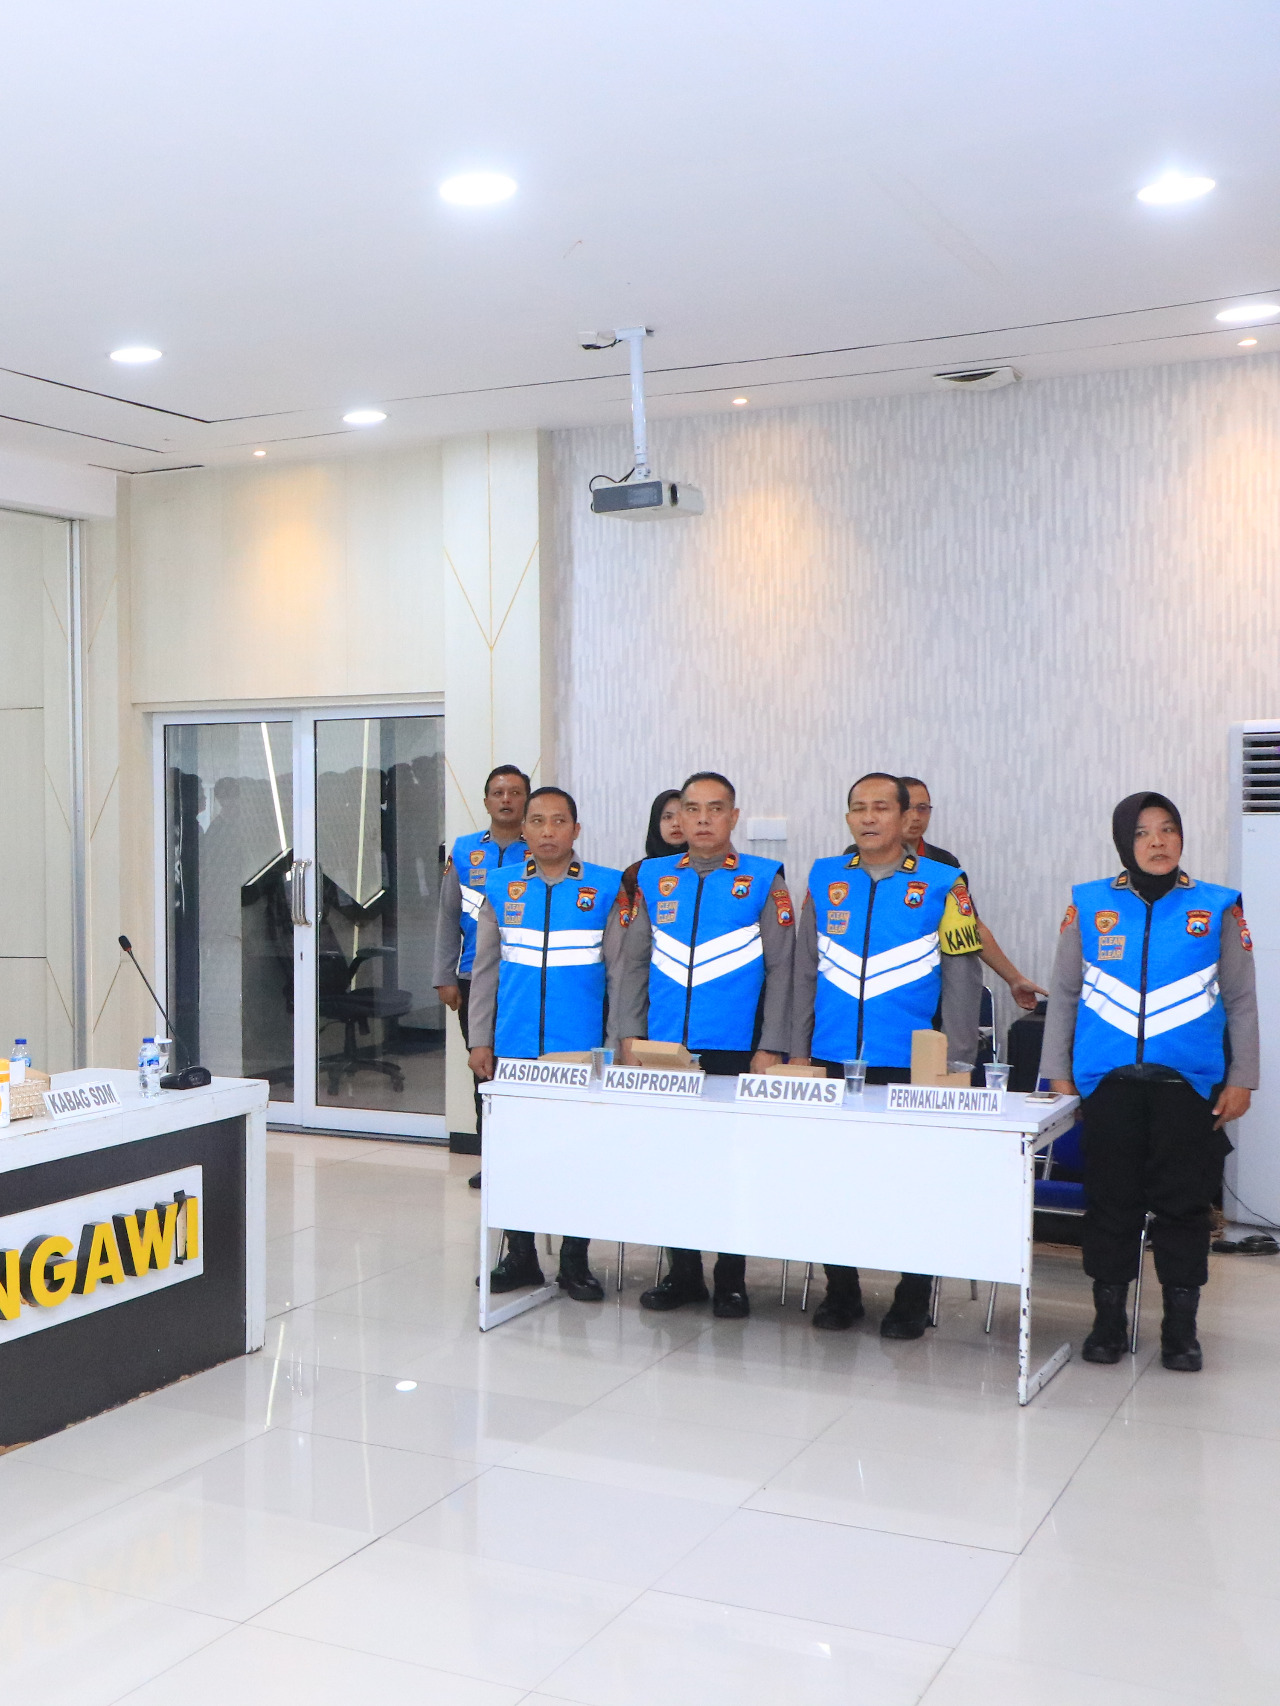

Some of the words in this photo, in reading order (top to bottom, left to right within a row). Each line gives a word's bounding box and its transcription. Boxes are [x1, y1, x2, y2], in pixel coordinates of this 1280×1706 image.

[498, 1062, 588, 1086] KASIDOKKES
[605, 1070, 700, 1094] KASIPROPAM
[47, 1089, 91, 1114] KABAG
[91, 1084, 118, 1106] SDM
[739, 1078, 837, 1103] KASIWAS
[890, 1088, 956, 1111] PERWAKILAN
[958, 1091, 999, 1112] PANITIA
